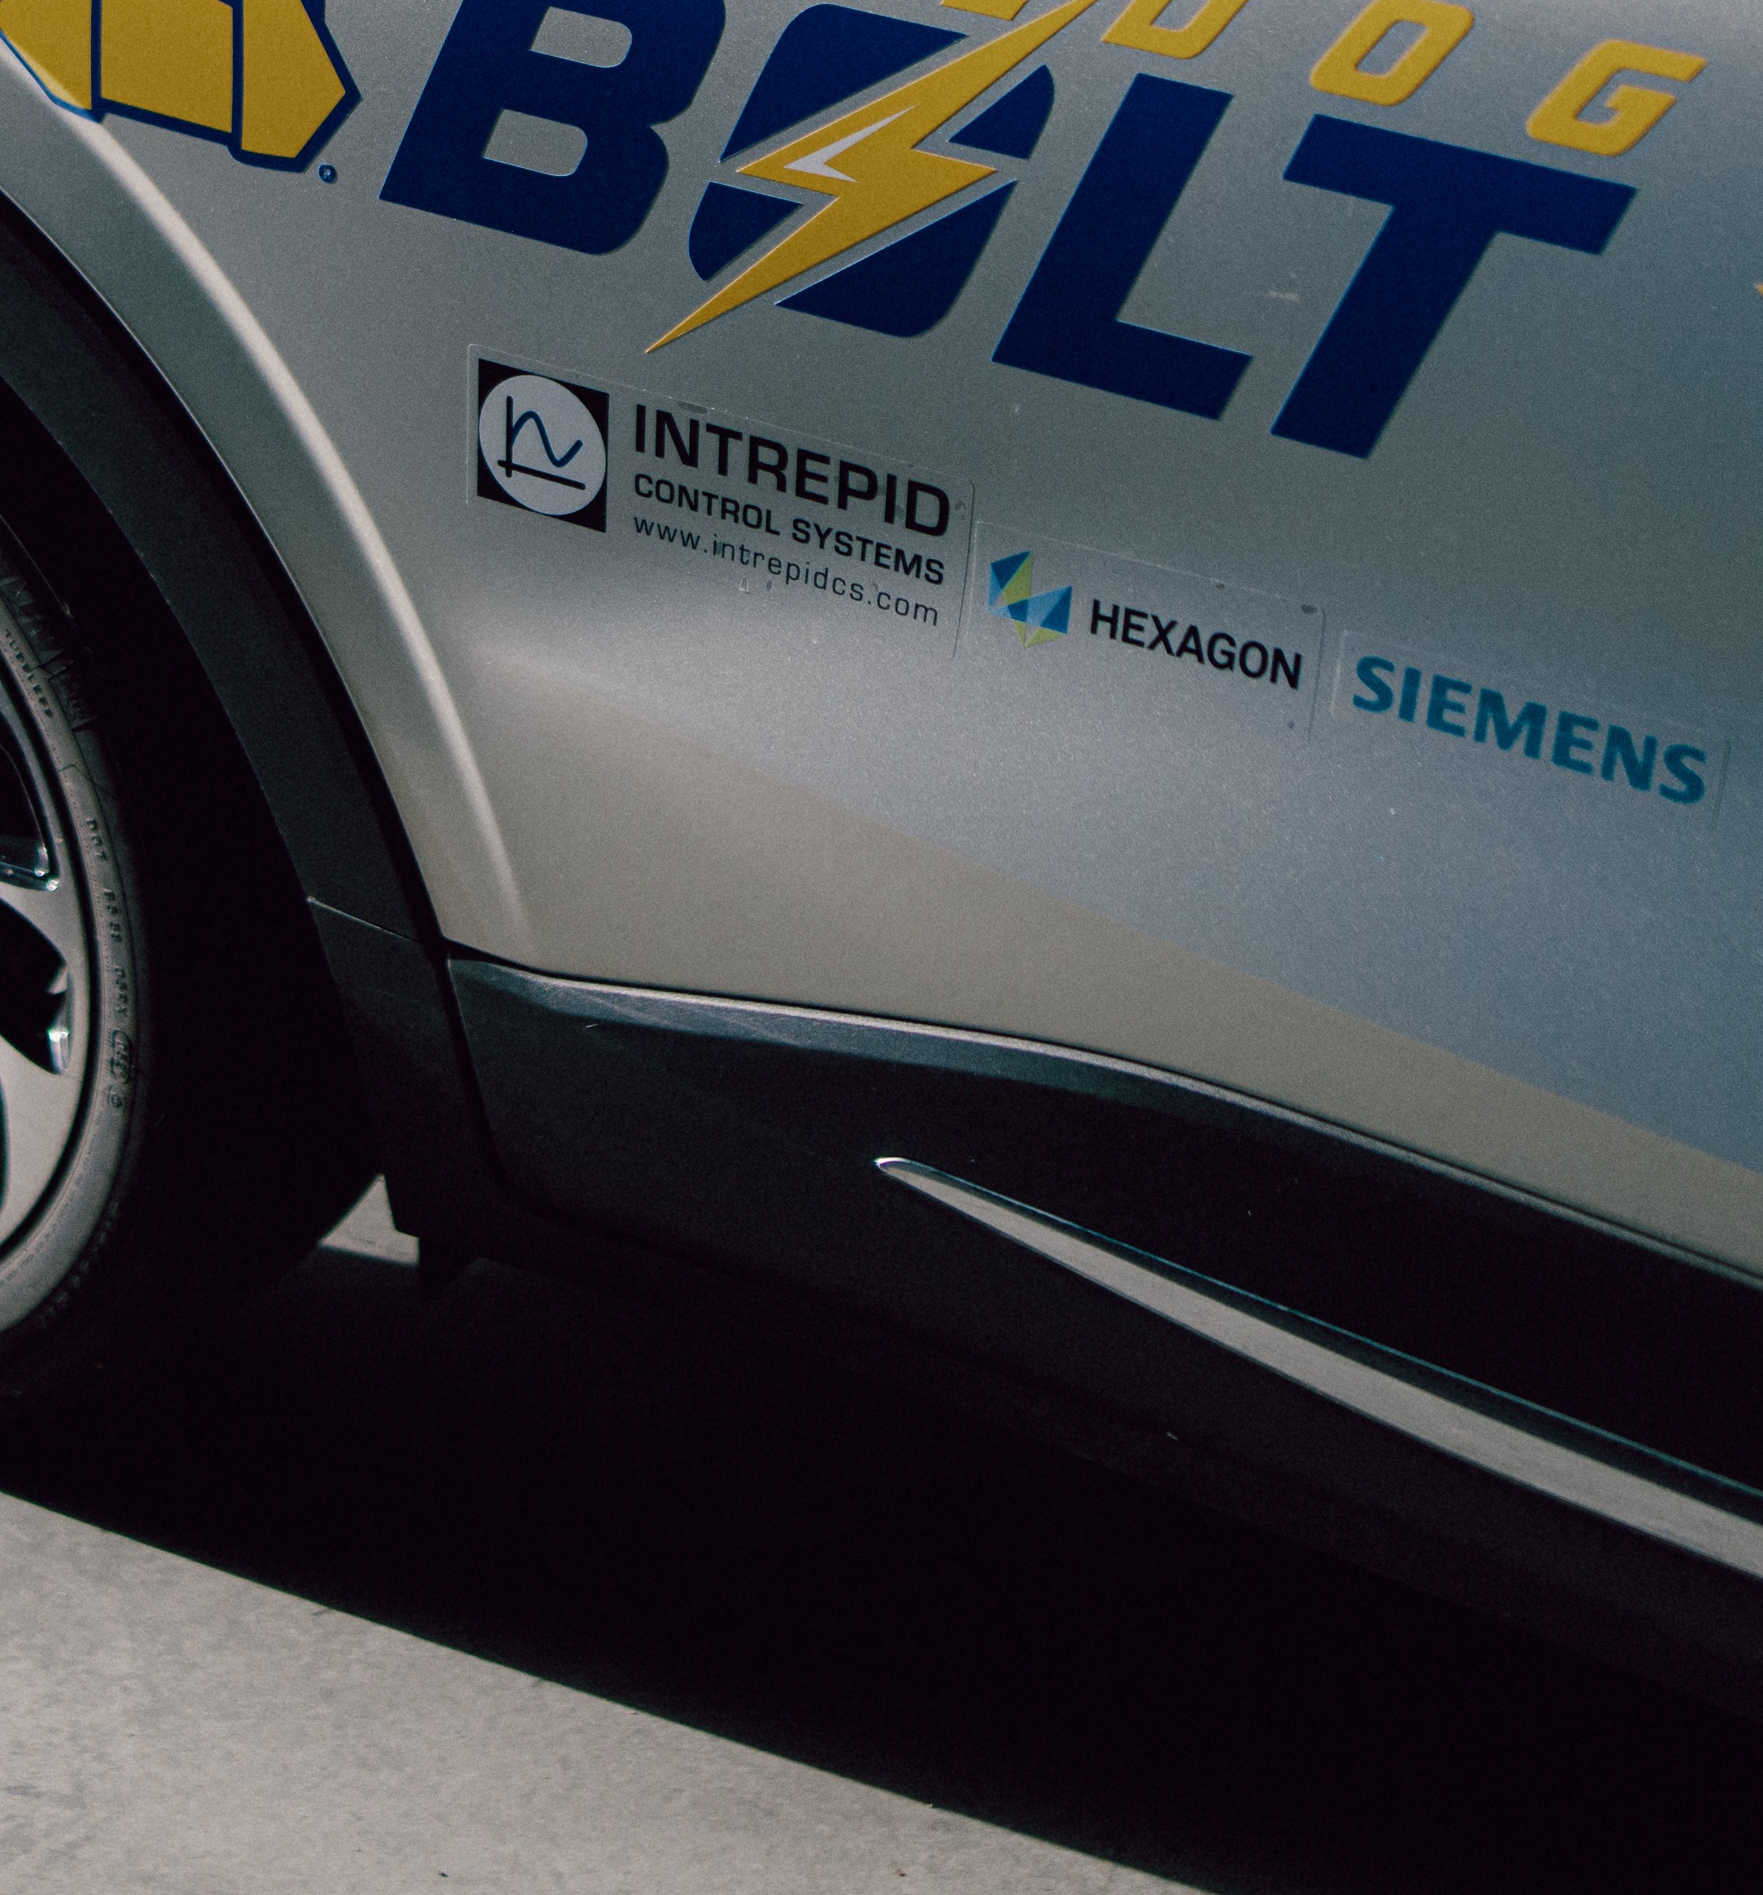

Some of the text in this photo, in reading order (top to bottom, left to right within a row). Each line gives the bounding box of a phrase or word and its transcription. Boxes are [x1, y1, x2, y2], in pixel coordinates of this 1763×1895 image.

[636, 404, 950, 537] INTREPID
[634, 473, 945, 586] CONTROL SYSTEMS
[634, 515, 939, 625] www.intrepidcs.com
[1089, 599, 1303, 689] HEXAGON
[1352, 655, 1708, 805] SIEMENS
